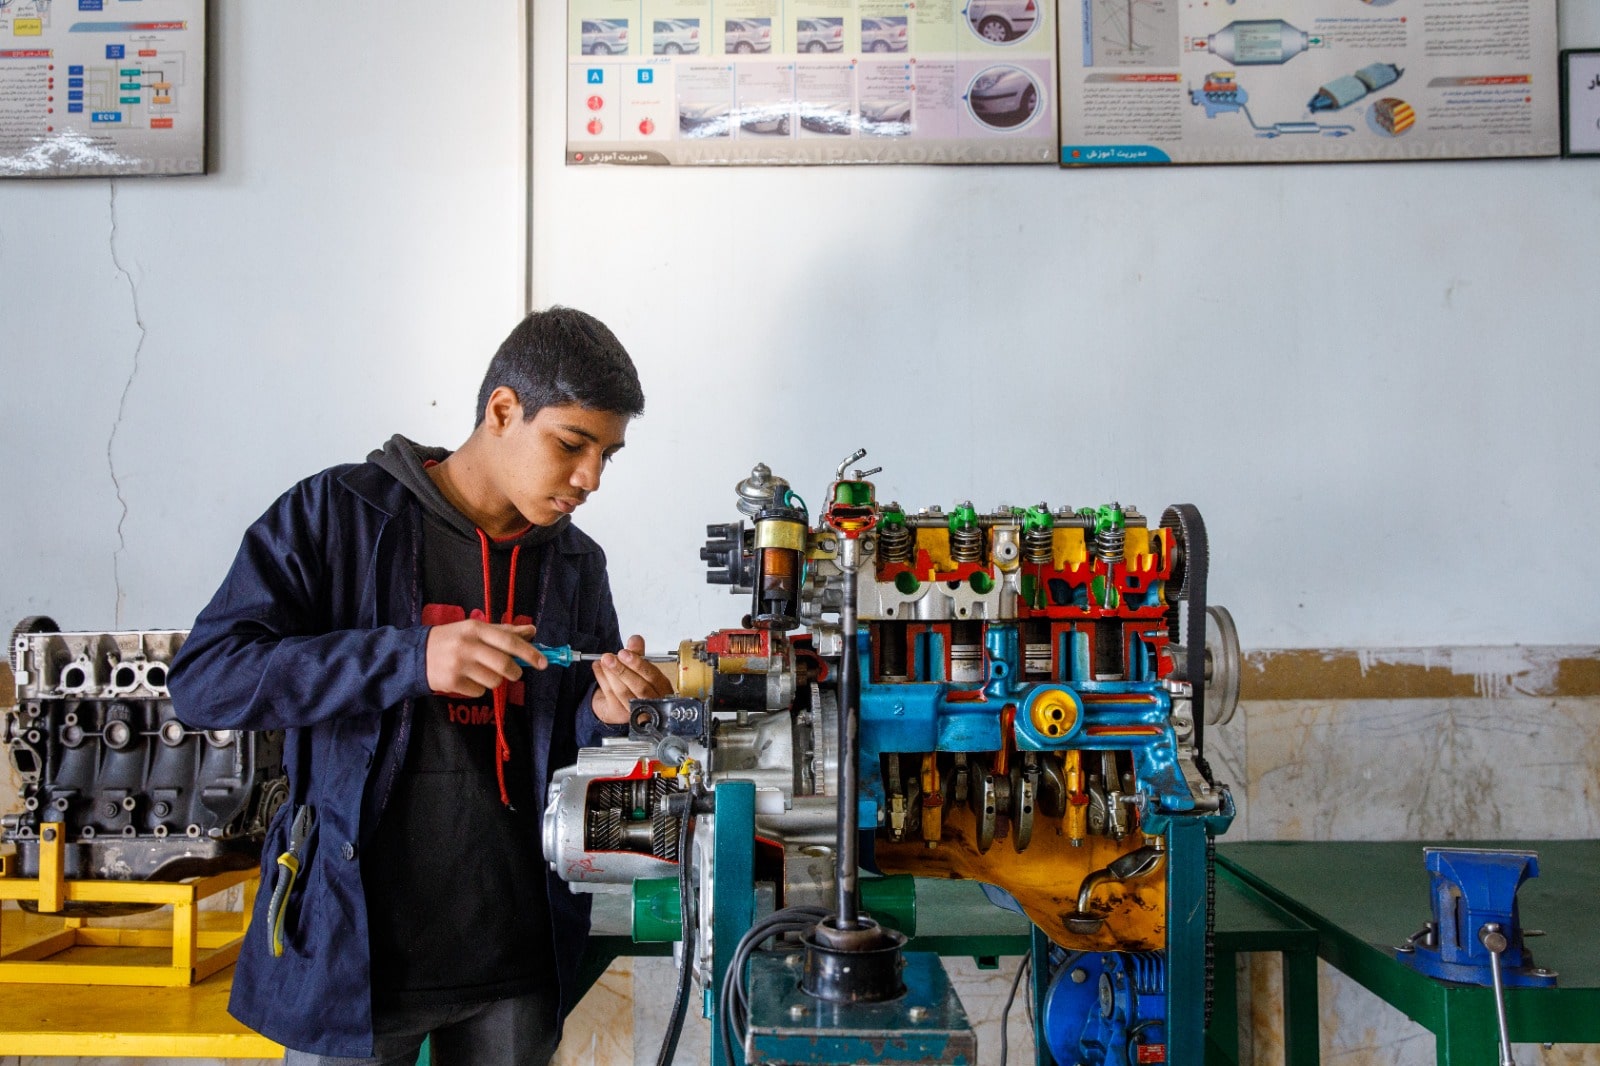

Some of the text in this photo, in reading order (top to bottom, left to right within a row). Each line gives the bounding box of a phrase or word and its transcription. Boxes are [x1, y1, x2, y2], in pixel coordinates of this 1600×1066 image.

[591, 71, 600, 81] A
[641, 71, 650, 81] B
[97, 113, 115, 121] ECU
[588, 152, 648, 163] مدیریت آموزش
[1086, 148, 1147, 160] مدیریت آموزش
